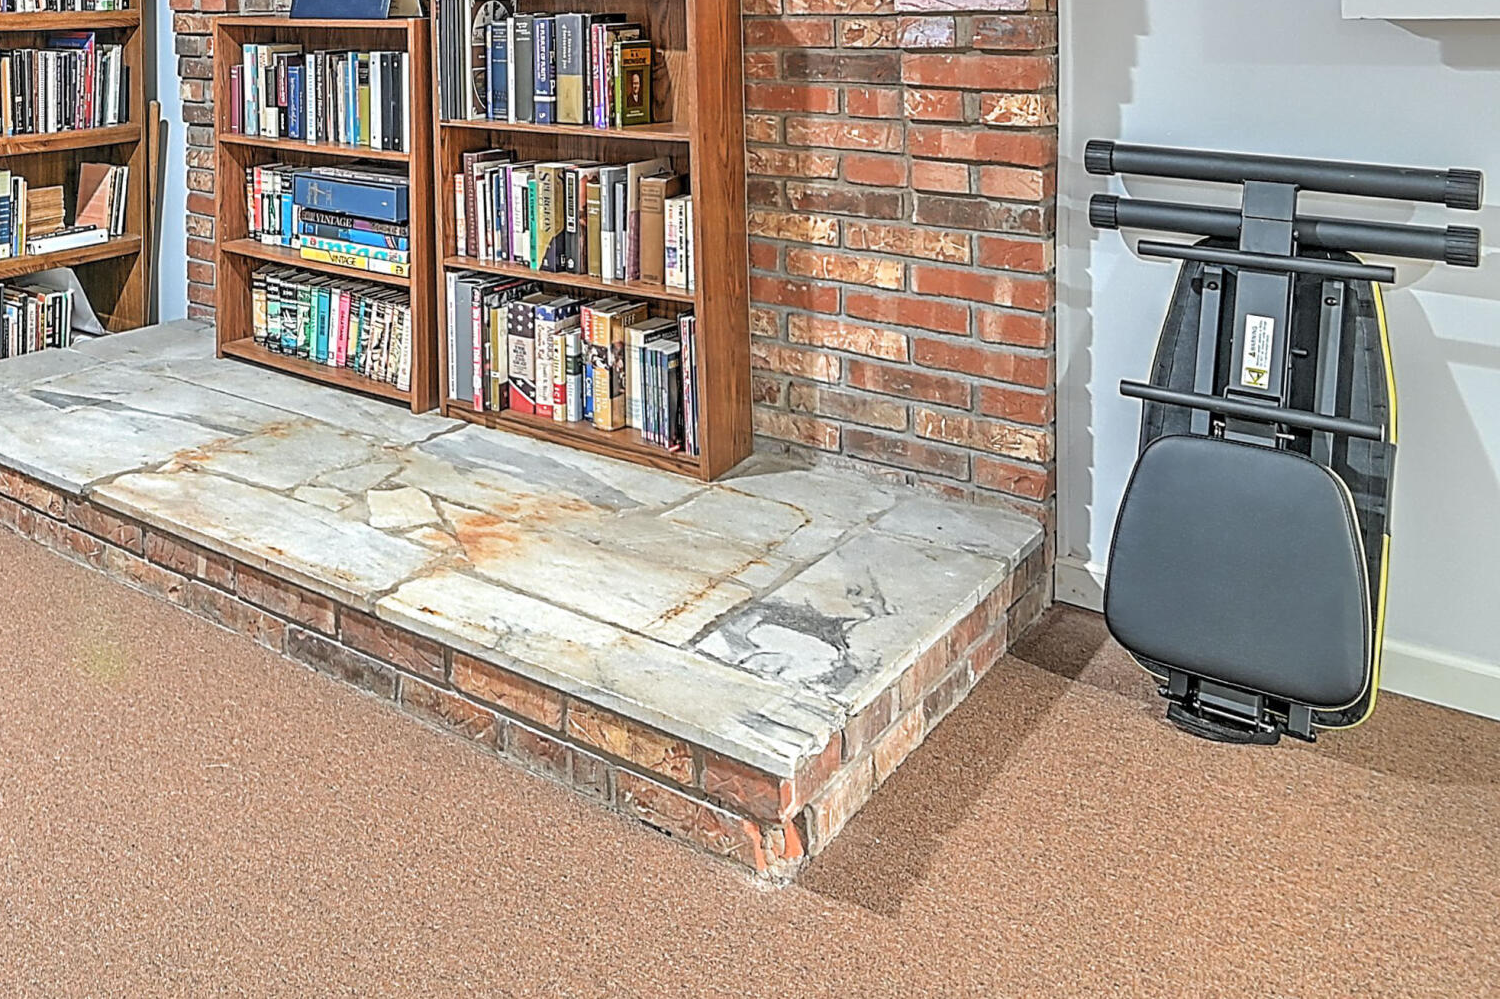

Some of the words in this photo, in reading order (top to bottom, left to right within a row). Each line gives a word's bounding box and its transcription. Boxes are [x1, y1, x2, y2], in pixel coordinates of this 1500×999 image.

[538, 171, 552, 233] SPURGEON
[315, 211, 353, 228] VINTAGE
[327, 250, 357, 267] VINTAGE
[622, 314, 635, 327] JEFF
[547, 326, 555, 360] AMERICA
